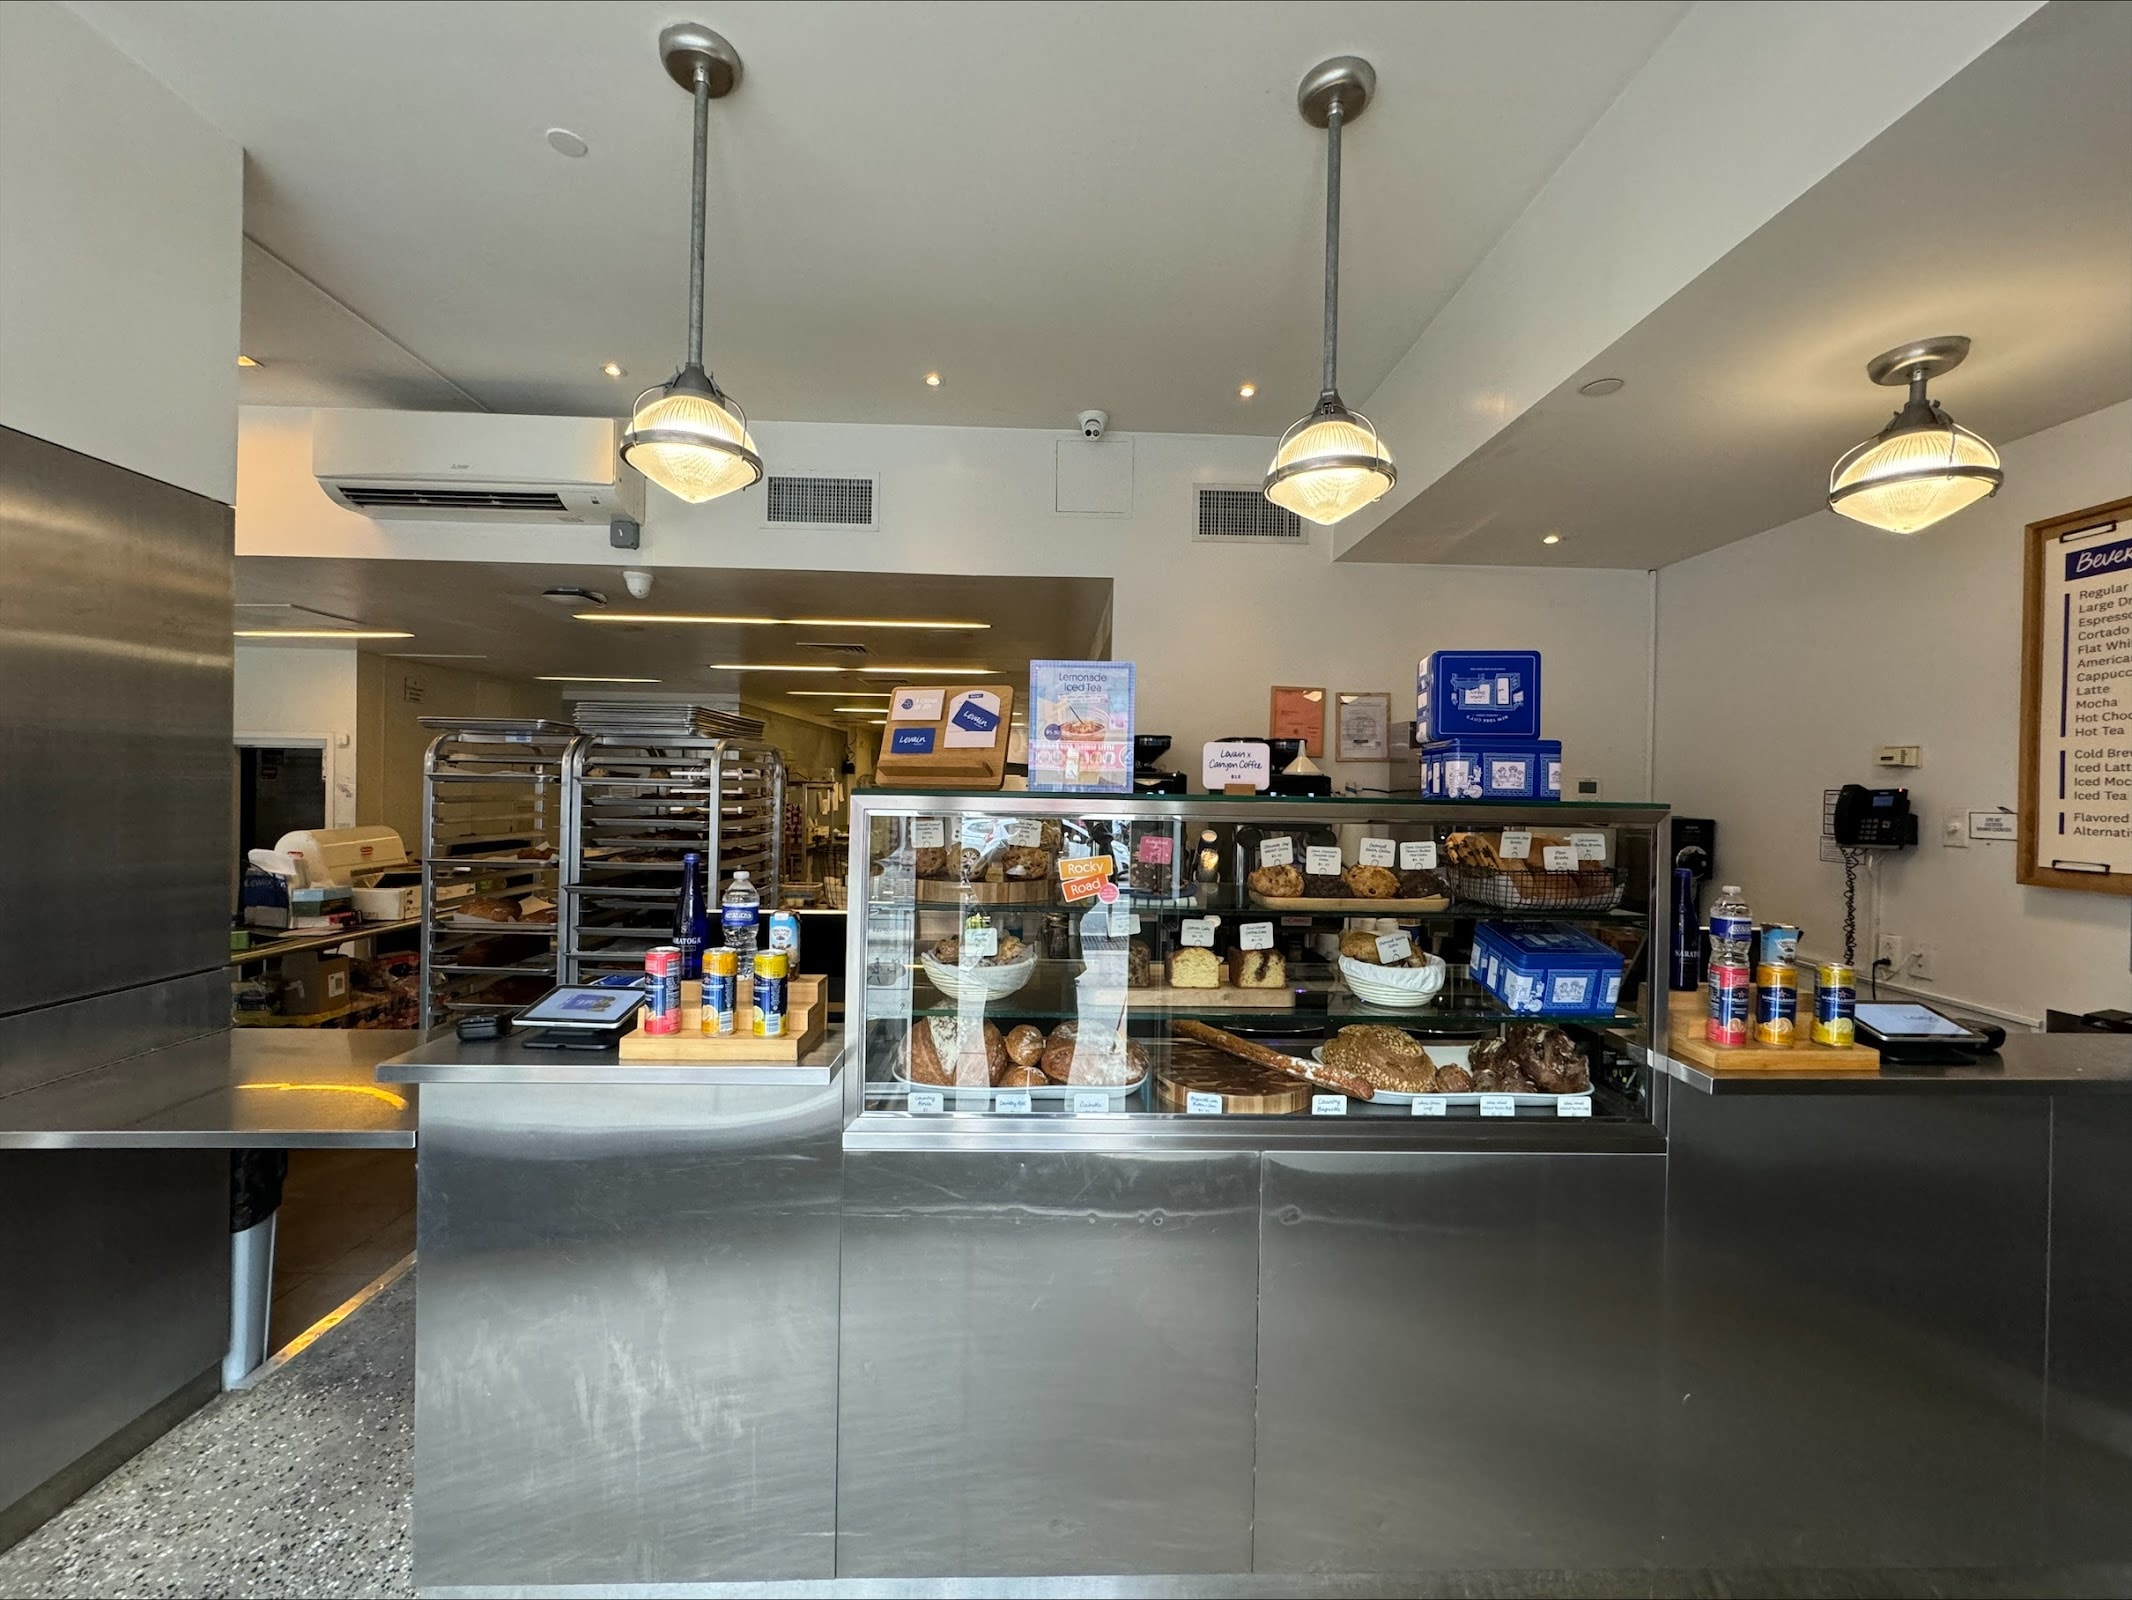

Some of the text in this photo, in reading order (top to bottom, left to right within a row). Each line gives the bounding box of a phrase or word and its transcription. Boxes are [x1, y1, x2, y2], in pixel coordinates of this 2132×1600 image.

[2080, 584, 2129, 599] Regular
[2079, 601, 2114, 614] Large
[2078, 626, 2130, 641] Cortado
[2078, 644, 2102, 654] Flat
[1059, 672, 1107, 682] Lemonade
[1064, 683, 1102, 692] Iced Tea
[2076, 685, 2110, 696] Latte
[2076, 698, 2118, 709] Mocha
[2076, 714, 2099, 723] Hot
[2076, 726, 2125, 736] Hot Tea
[2074, 748, 2104, 759] Cold
[1209, 759, 1262, 772] Canyon Coffee
[2074, 762, 2100, 772] Iced
[2074, 777, 2100, 786] Iced
[2074, 790, 2128, 800] Iced Tea
[2074, 812, 2130, 823] Flavored
[1068, 862, 1104, 874] Rocky
[1070, 880, 1101, 896] Road
